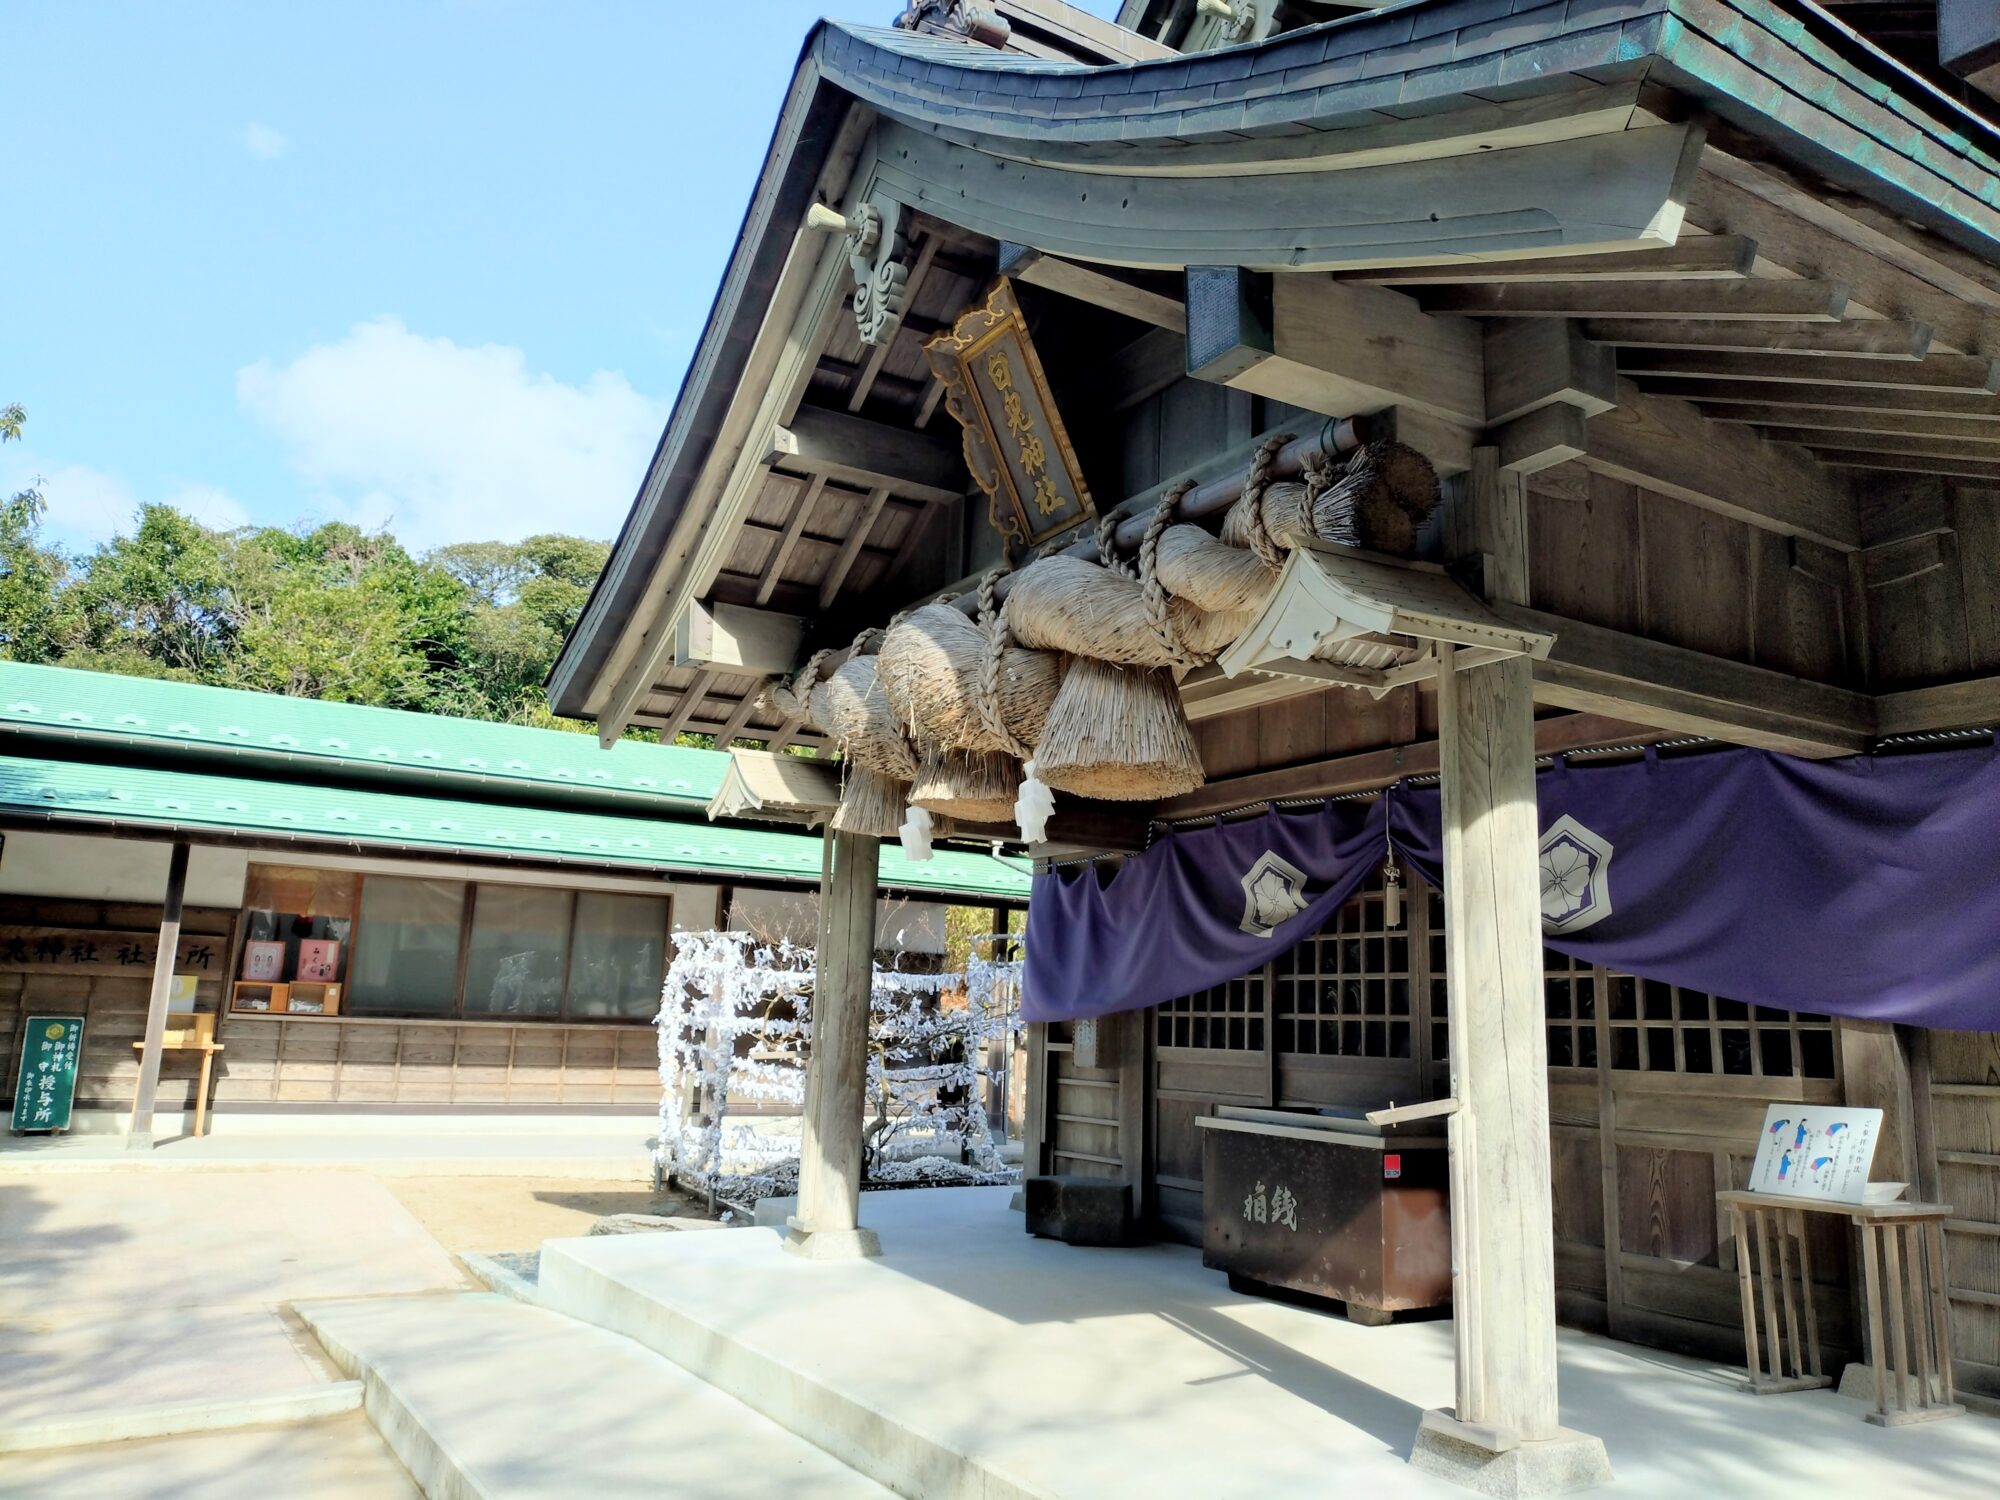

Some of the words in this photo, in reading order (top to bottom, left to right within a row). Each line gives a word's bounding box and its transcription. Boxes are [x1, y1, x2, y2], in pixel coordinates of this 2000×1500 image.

[115, 941, 215, 970] 社所
[50, 1041, 66, 1073] 御神札
[33, 1074, 57, 1123] 授与所
